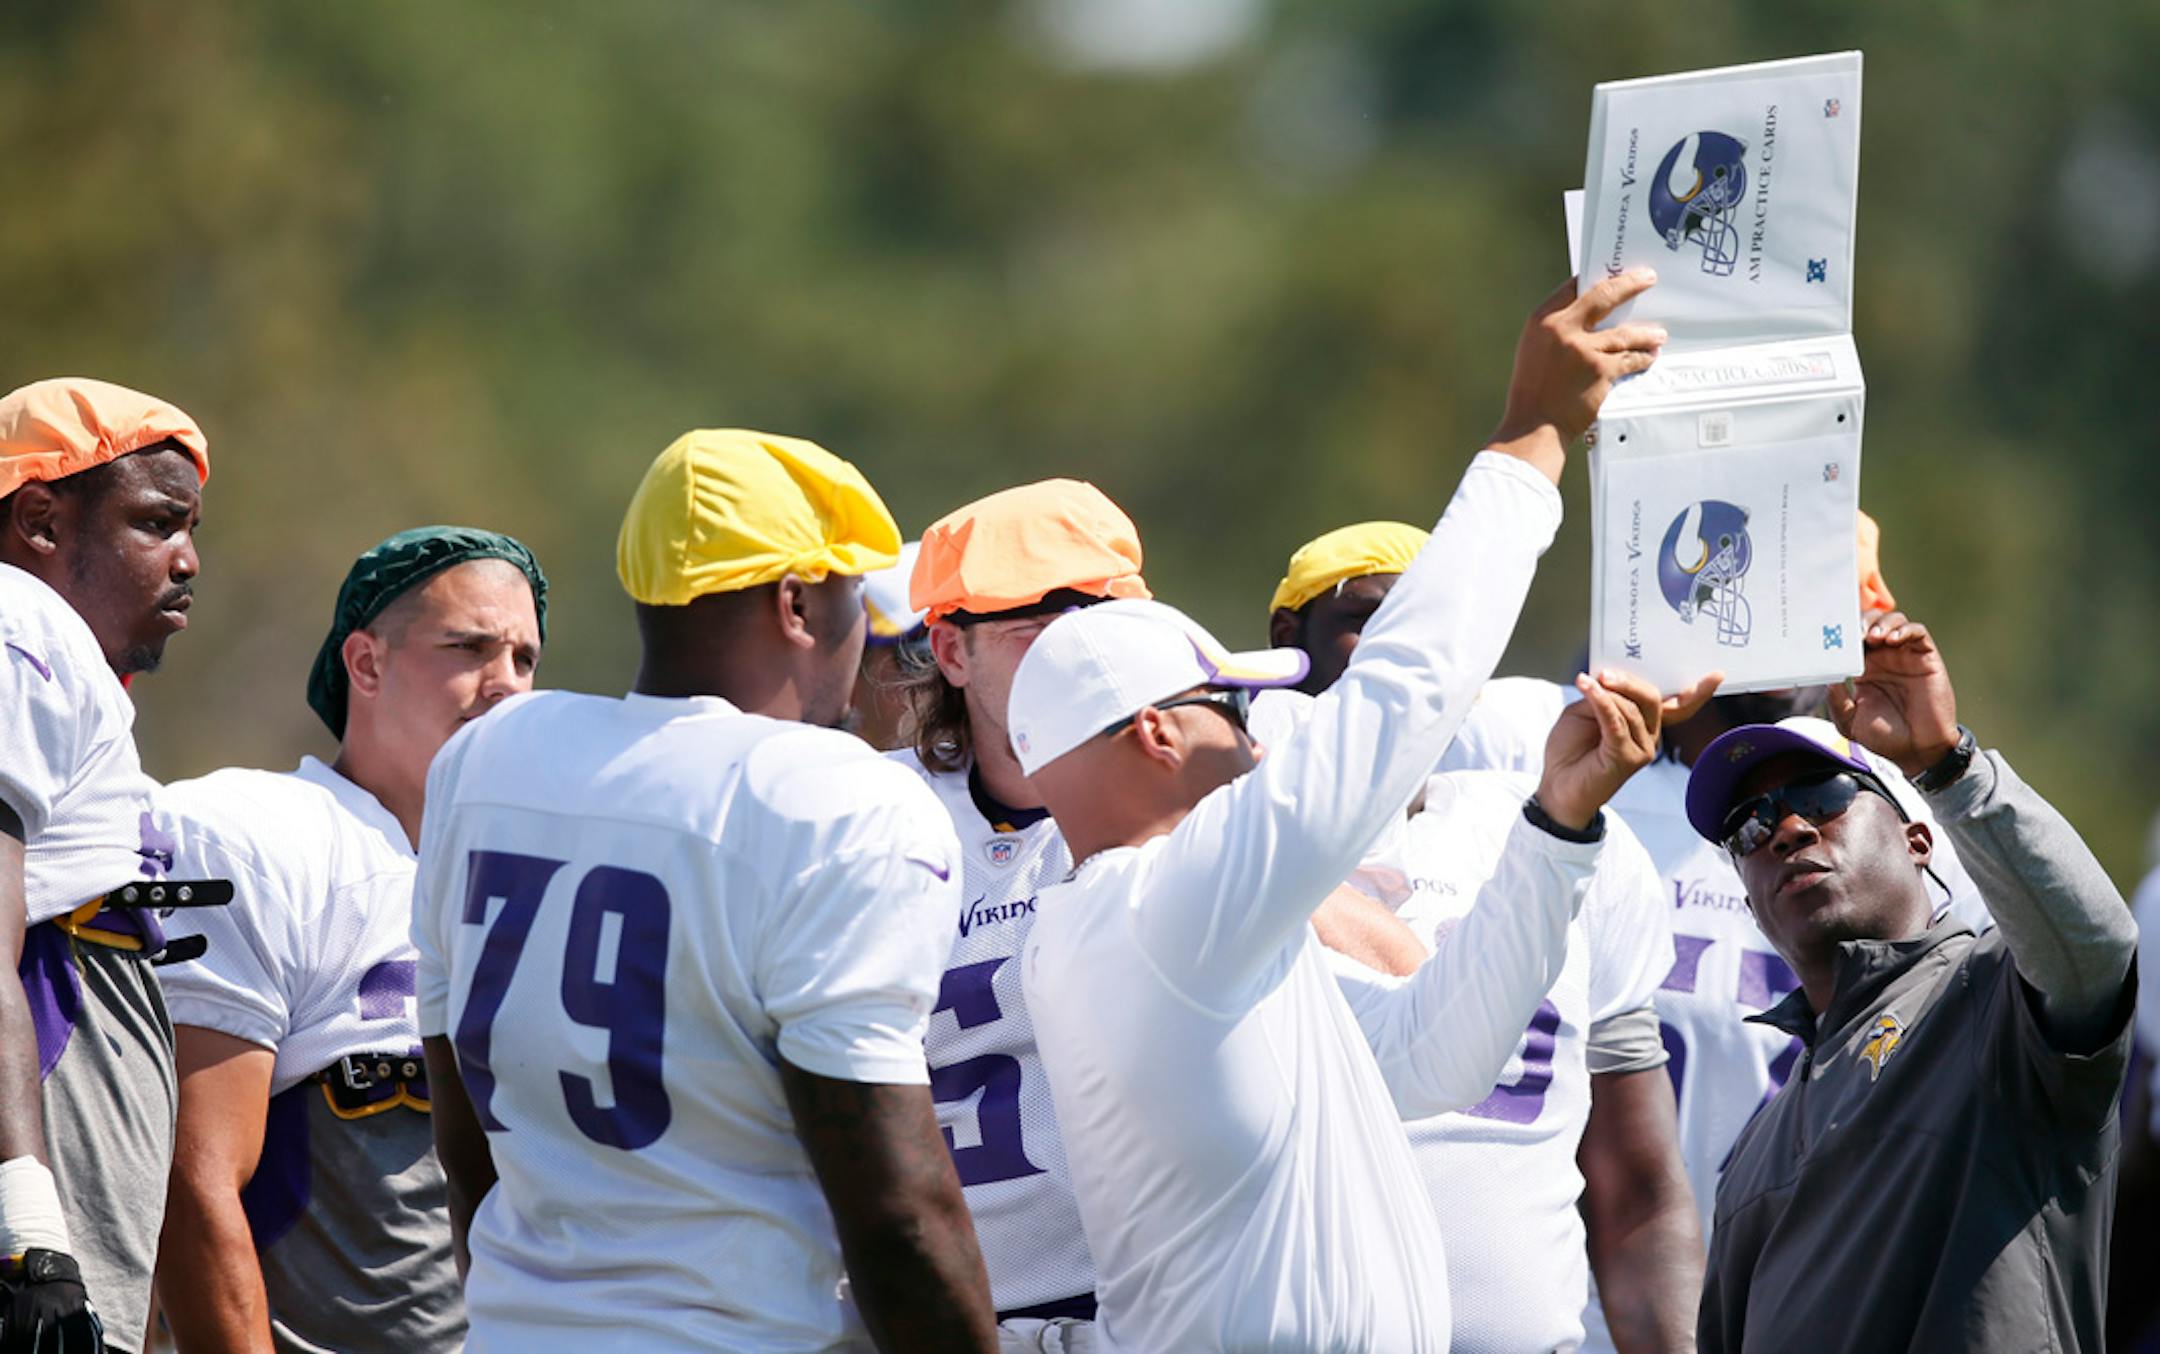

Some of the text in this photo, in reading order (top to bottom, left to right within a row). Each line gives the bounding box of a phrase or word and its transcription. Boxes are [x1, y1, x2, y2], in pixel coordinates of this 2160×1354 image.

[1749, 104, 1777, 284] AM PRACTICE CARDS
[453, 849, 672, 1151] 79
